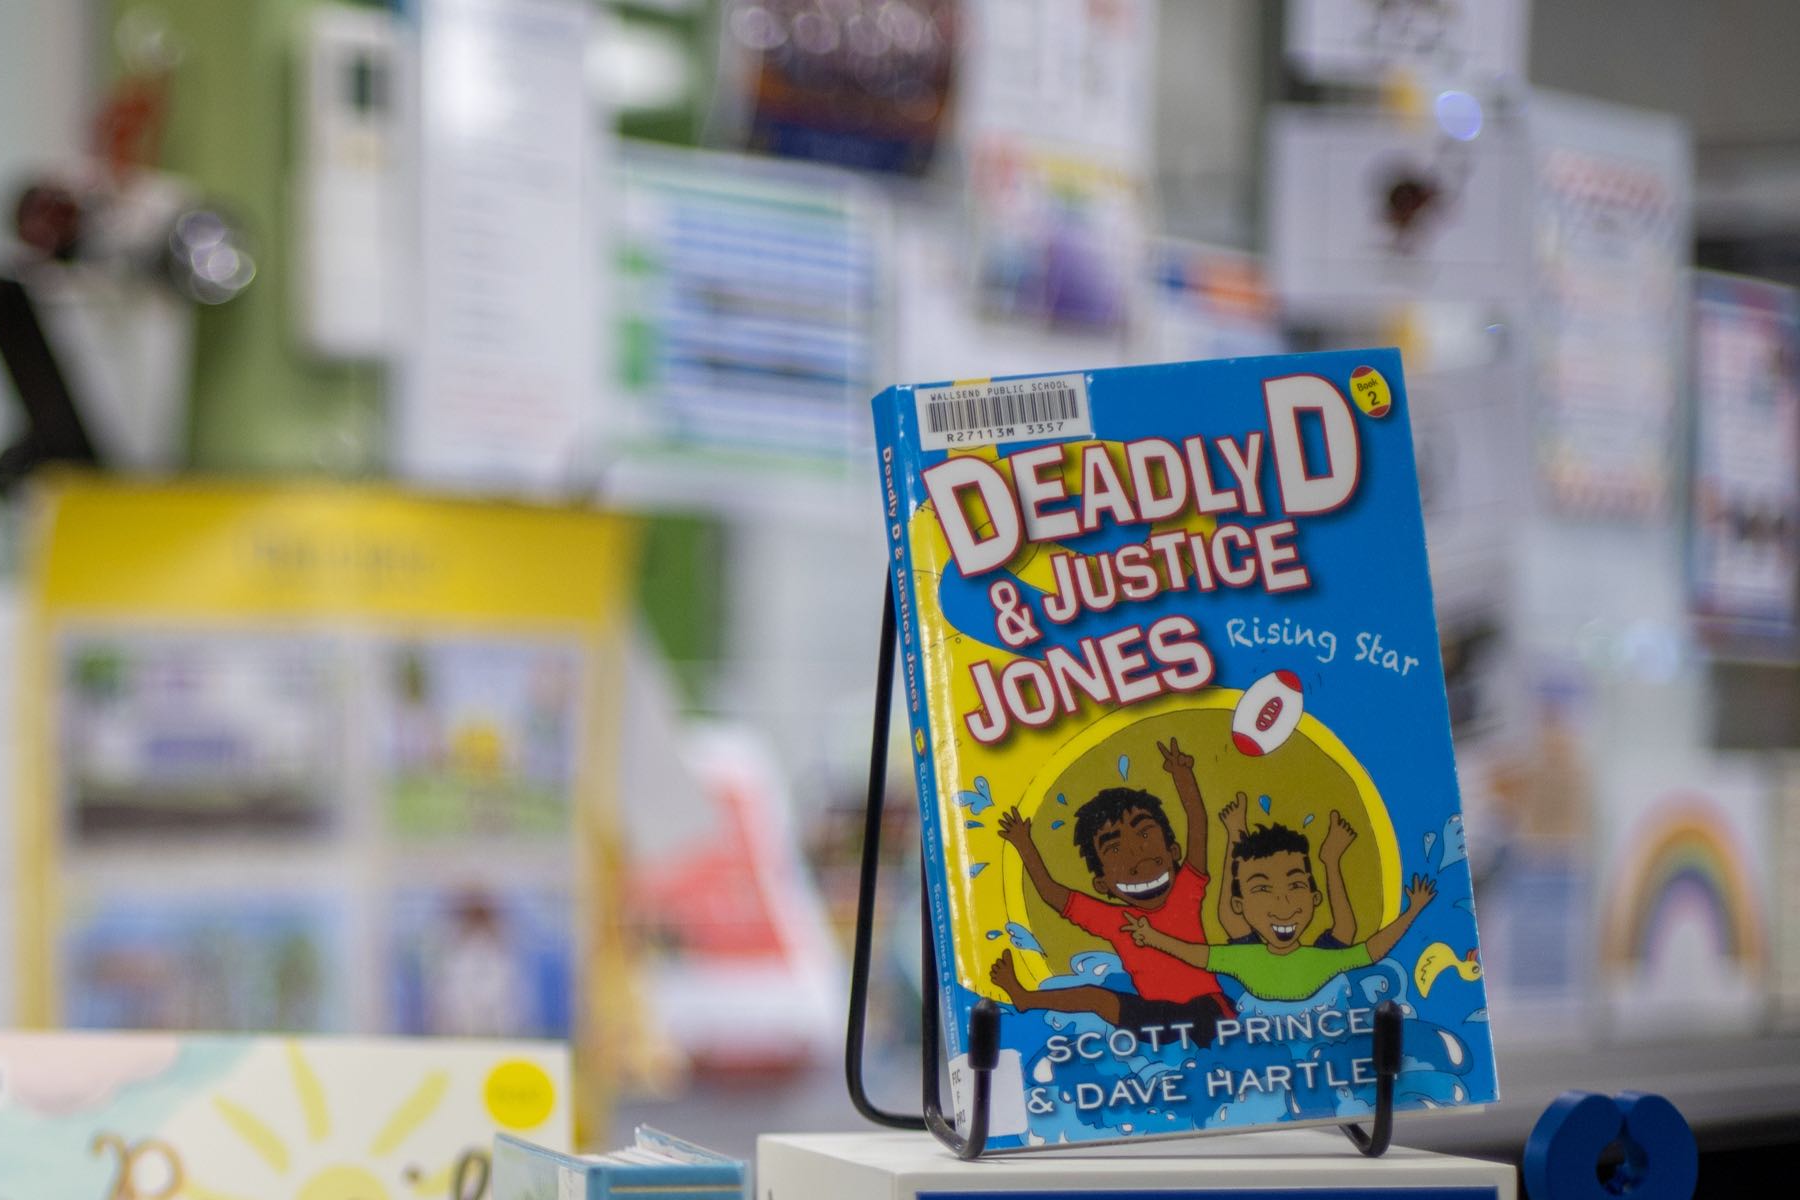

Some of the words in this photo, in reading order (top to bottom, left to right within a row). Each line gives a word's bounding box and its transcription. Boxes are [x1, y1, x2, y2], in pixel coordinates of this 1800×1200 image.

[930, 389, 981, 401] WALLSEND
[988, 384, 1025, 395] PUBLIC
[1031, 381, 1069, 392] SCHOOL
[1357, 378, 1378, 392] Book
[1368, 391, 1380, 406] 2
[946, 427, 1015, 442] R27113M
[1026, 422, 1064, 435] 3357
[881, 446, 898, 518] Deadly
[921, 430, 1264, 580] DEADLY
[1261, 373, 1362, 518] D
[892, 524, 903, 541] D
[894, 546, 905, 560] &
[896, 566, 914, 646] Justice
[988, 578, 1043, 650] &
[1043, 519, 1313, 626] JUSTICE
[1225, 617, 1338, 662] Rising
[1354, 632, 1420, 676] Star
[905, 651, 921, 713] Jones
[963, 613, 1218, 747] JONES
[1046, 1021, 1196, 1066] SCOTT
[1216, 1007, 1377, 1046] PRINCE
[1027, 1086, 1055, 1116] &
[1075, 1075, 1189, 1109] DAVE
